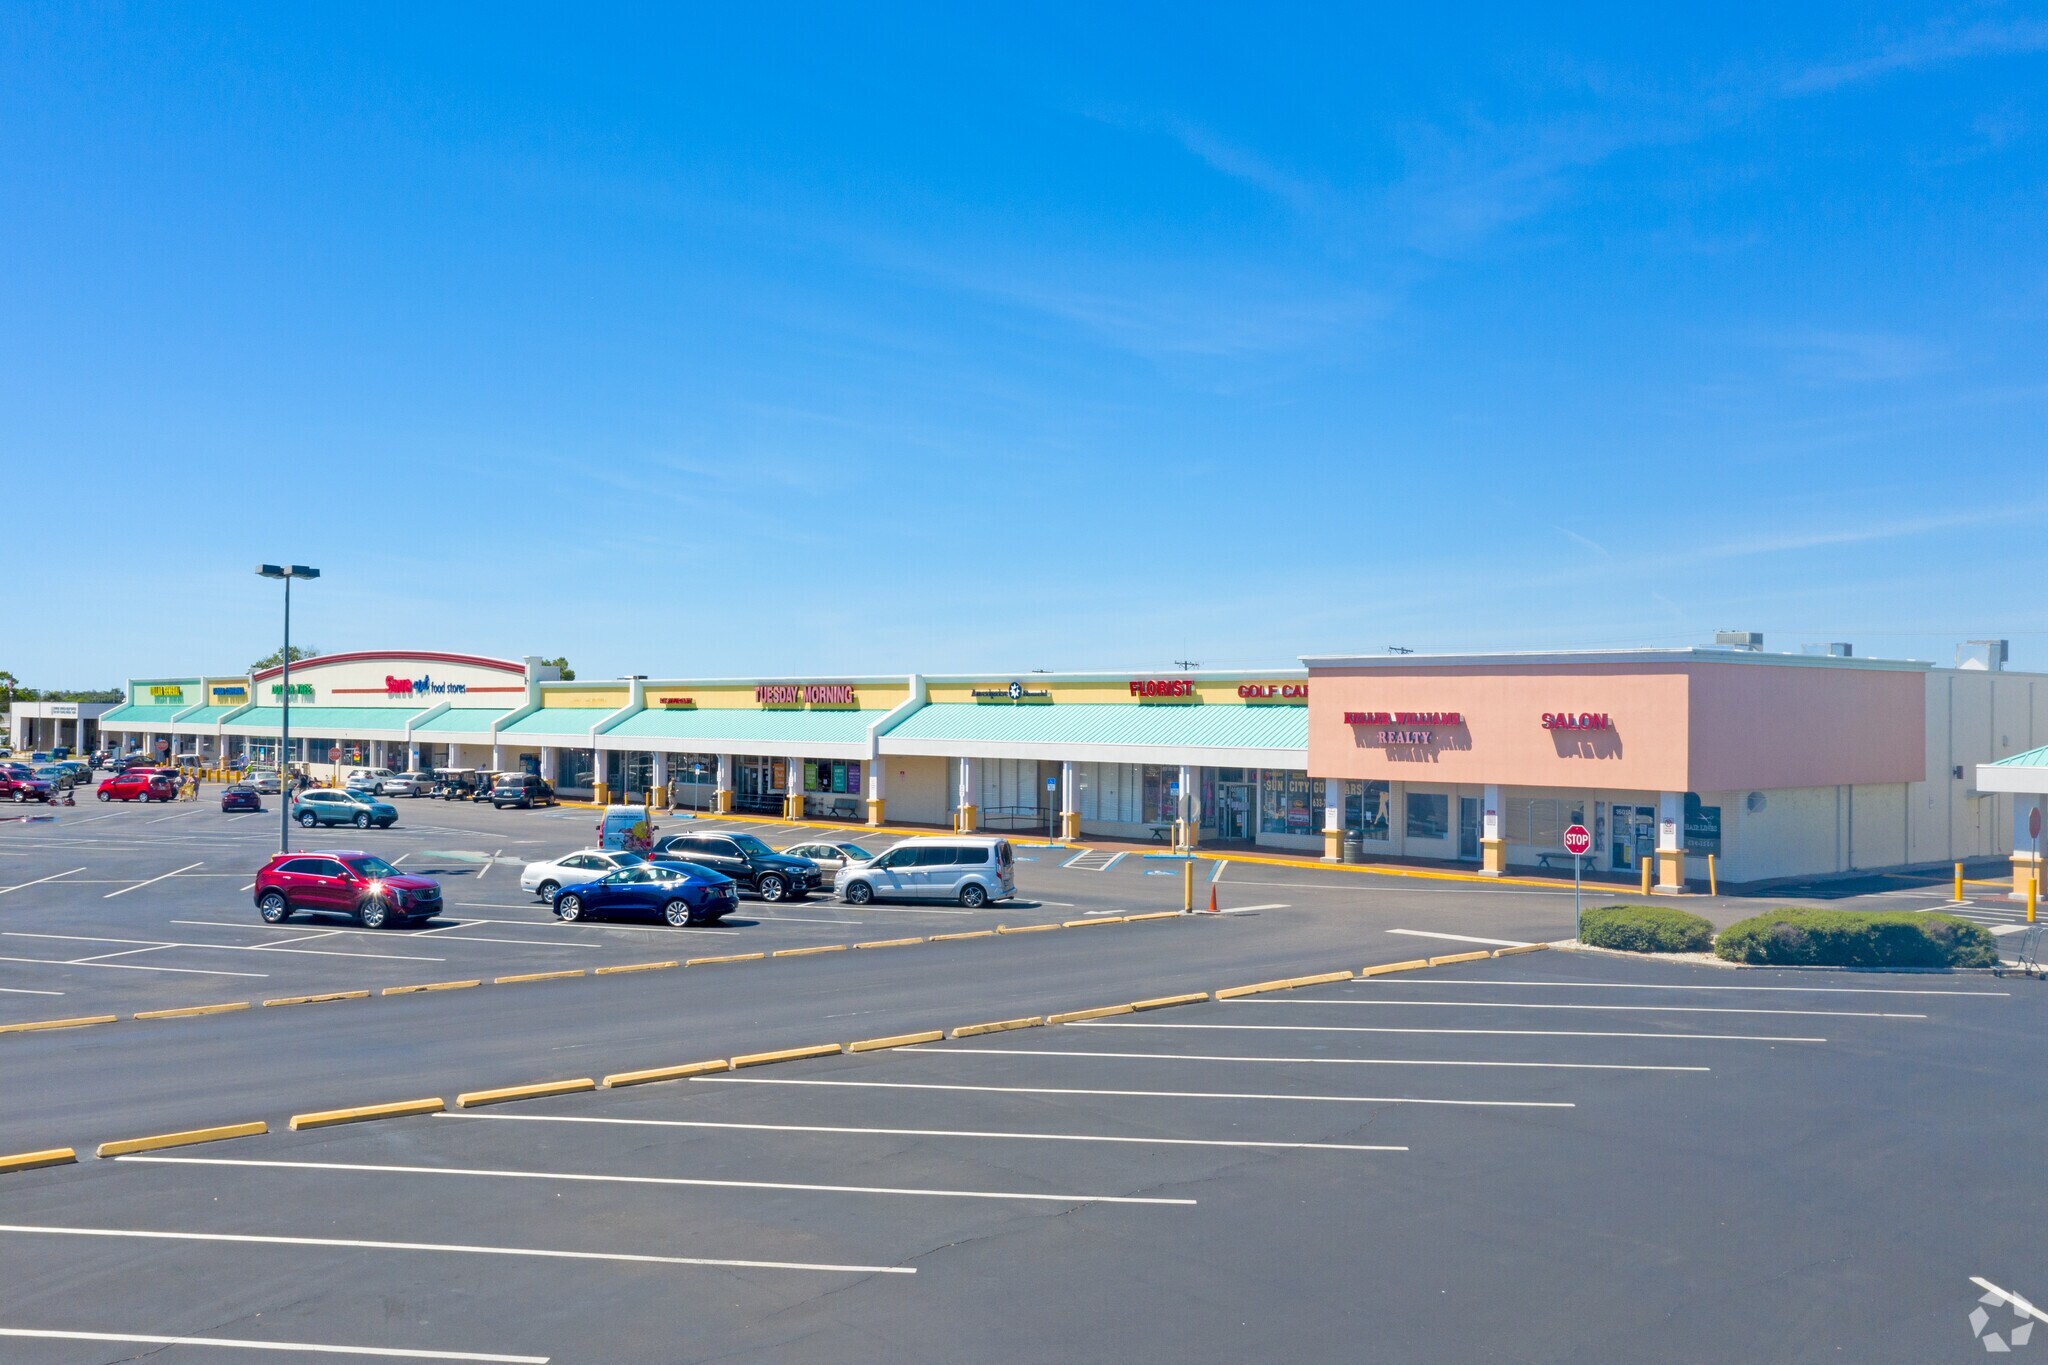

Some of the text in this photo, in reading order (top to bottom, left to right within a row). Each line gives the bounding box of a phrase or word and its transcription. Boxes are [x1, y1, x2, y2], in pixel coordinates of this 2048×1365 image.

[386, 675, 412, 693] Save
[431, 681, 446, 693] food
[447, 682, 466, 693] stores
[1129, 680, 1194, 698] FLORIST
[1238, 684, 1278, 698] GOLF
[754, 686, 855, 703] TUESDAY MORNING
[1344, 712, 1461, 725] KELLER WILLIAMS
[1541, 712, 1608, 730] SALON
[1378, 731, 1432, 745] REALTY
[1266, 780, 1362, 795] SUN CITY GO ARS
[1566, 833, 1588, 846] STOP
